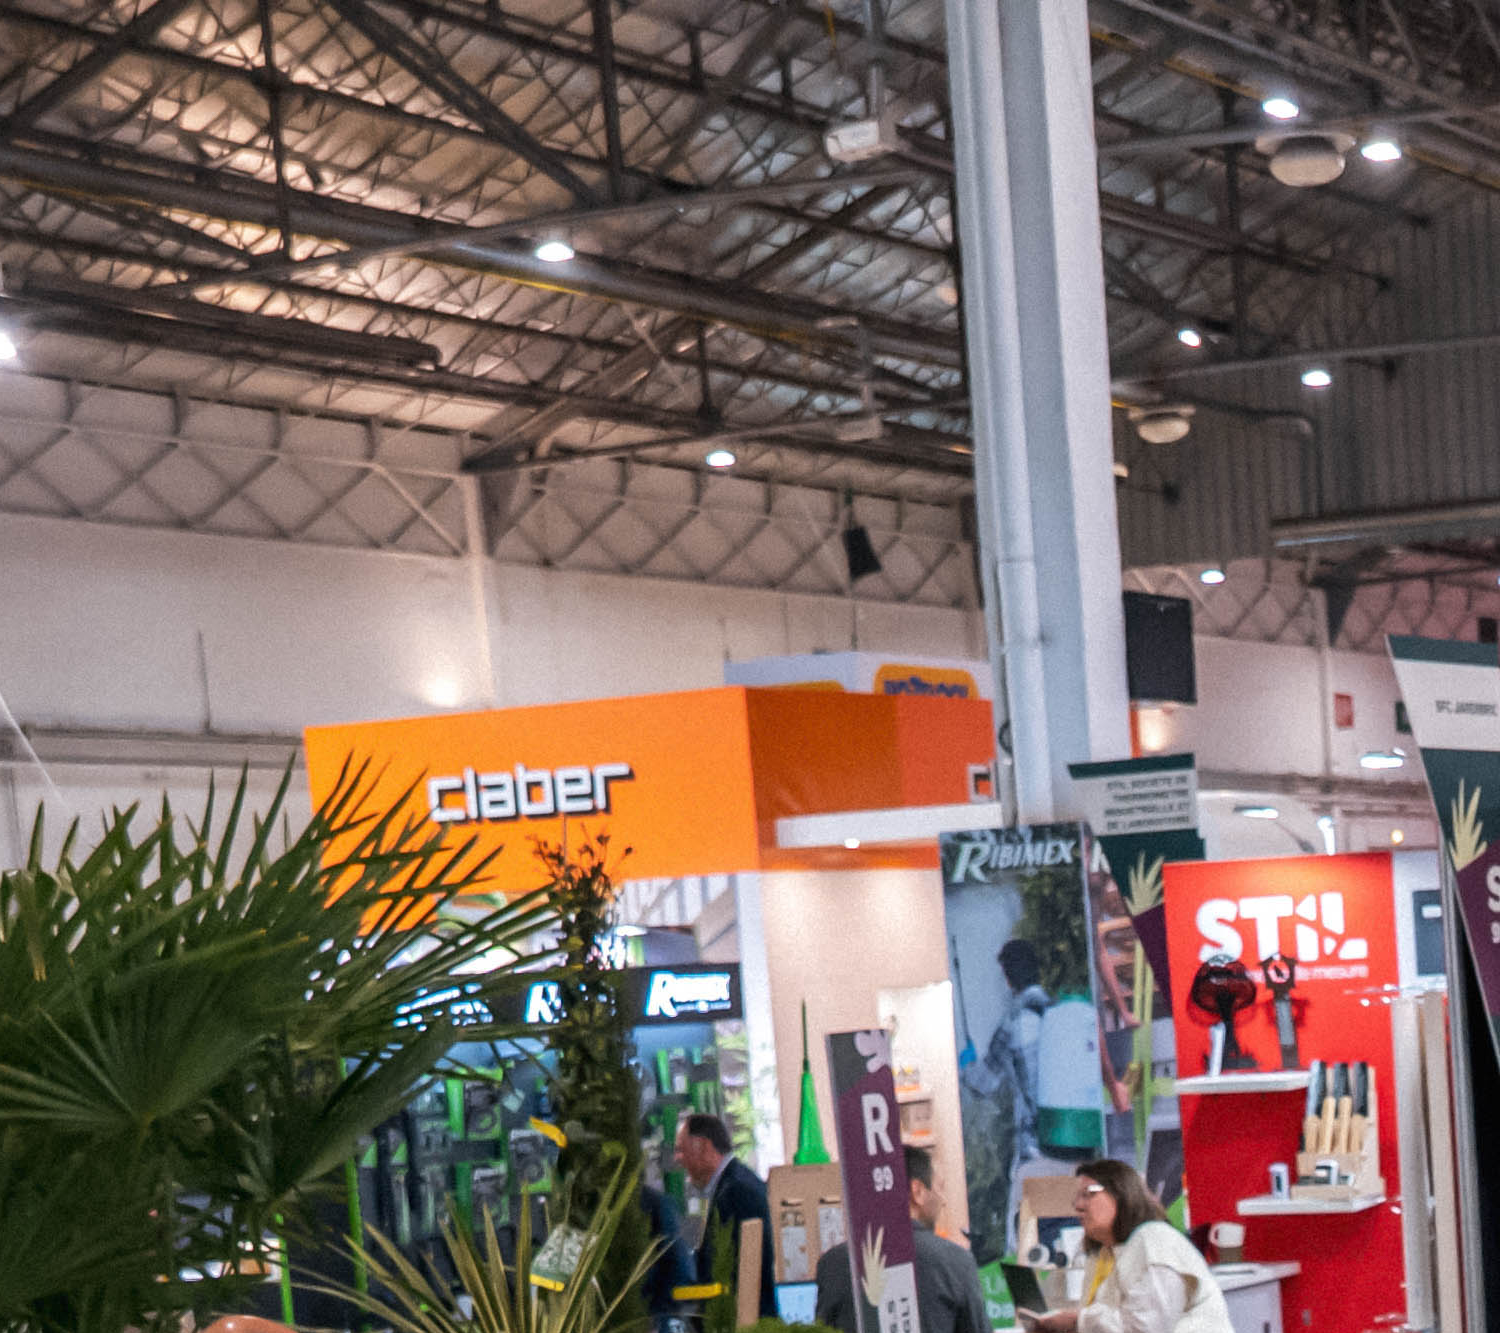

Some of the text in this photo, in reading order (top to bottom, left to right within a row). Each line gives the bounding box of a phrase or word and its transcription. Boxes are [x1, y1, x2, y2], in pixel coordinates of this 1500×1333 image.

[427, 763, 630, 822] claber
[952, 839, 1076, 884] RIBIMEX
[861, 1093, 894, 1155] R
